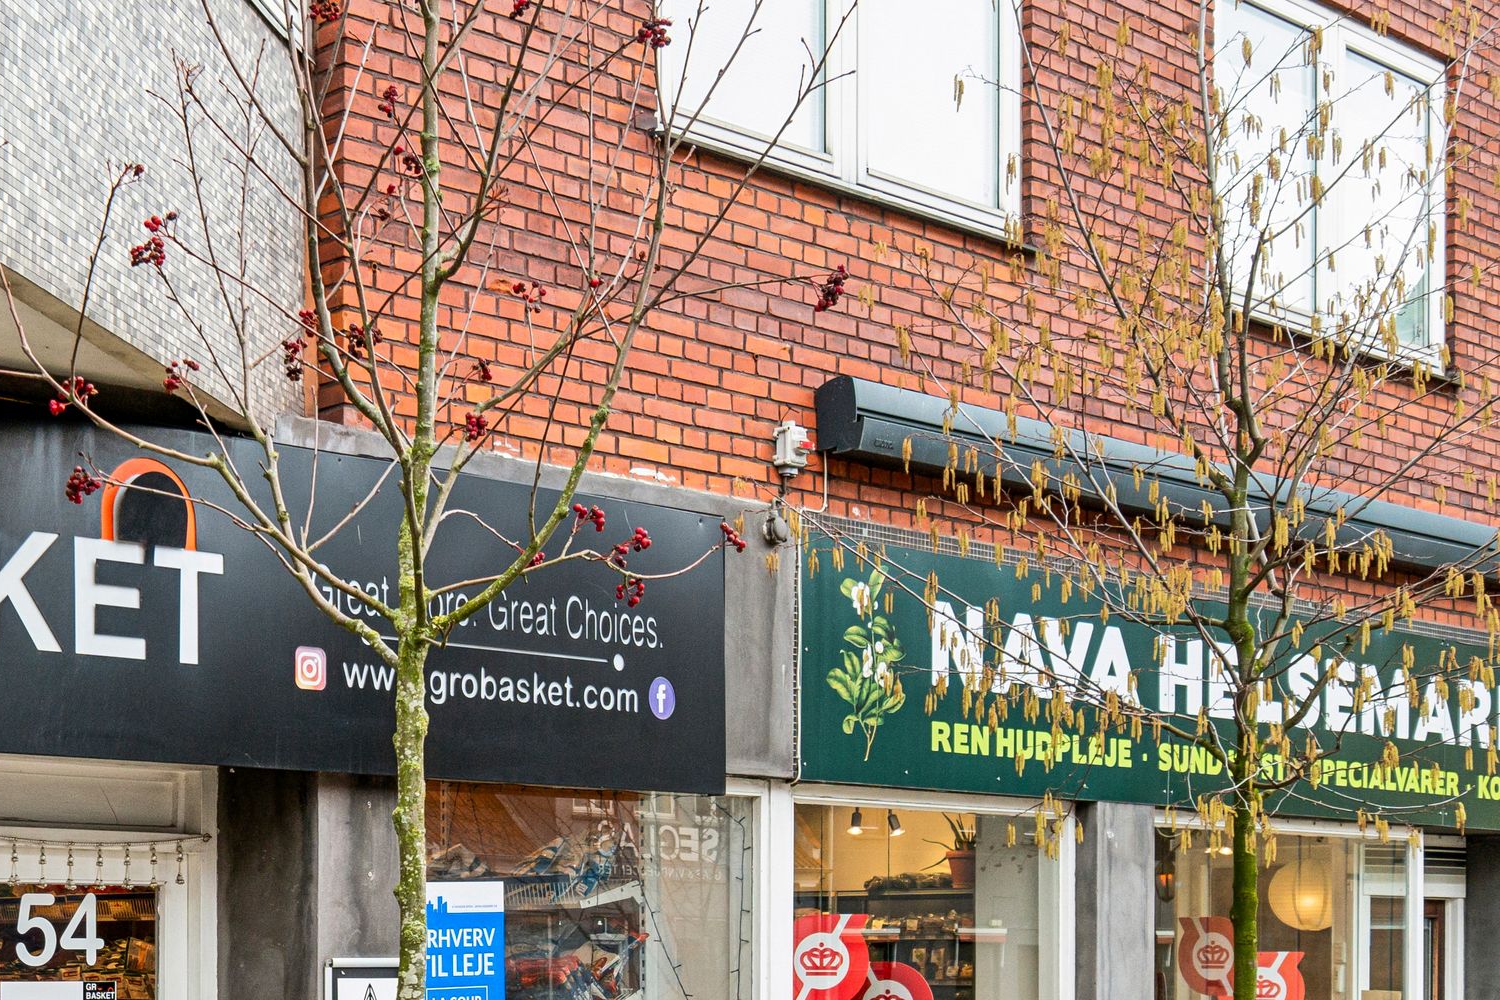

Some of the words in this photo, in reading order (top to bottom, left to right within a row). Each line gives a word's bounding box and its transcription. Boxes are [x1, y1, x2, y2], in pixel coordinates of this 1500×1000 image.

[311, 564, 389, 617] Great
[488, 590, 557, 636] Great
[566, 594, 665, 649] Choices.
[343, 660, 639, 714] wwgrobasket.com
[931, 600, 1141, 709] NAVA
[1158, 633, 1500, 751] HELSEMAR
[931, 721, 990, 757] REN
[996, 727, 1133, 769] HUDPLEJE
[1157, 742, 1223, 776] SUND
[15, 892, 105, 969] 54
[427, 928, 496, 949] RHVERV
[427, 953, 448, 977] IL
[453, 952, 495, 977] LEJE
[85, 991, 115, 1000] BASKET
